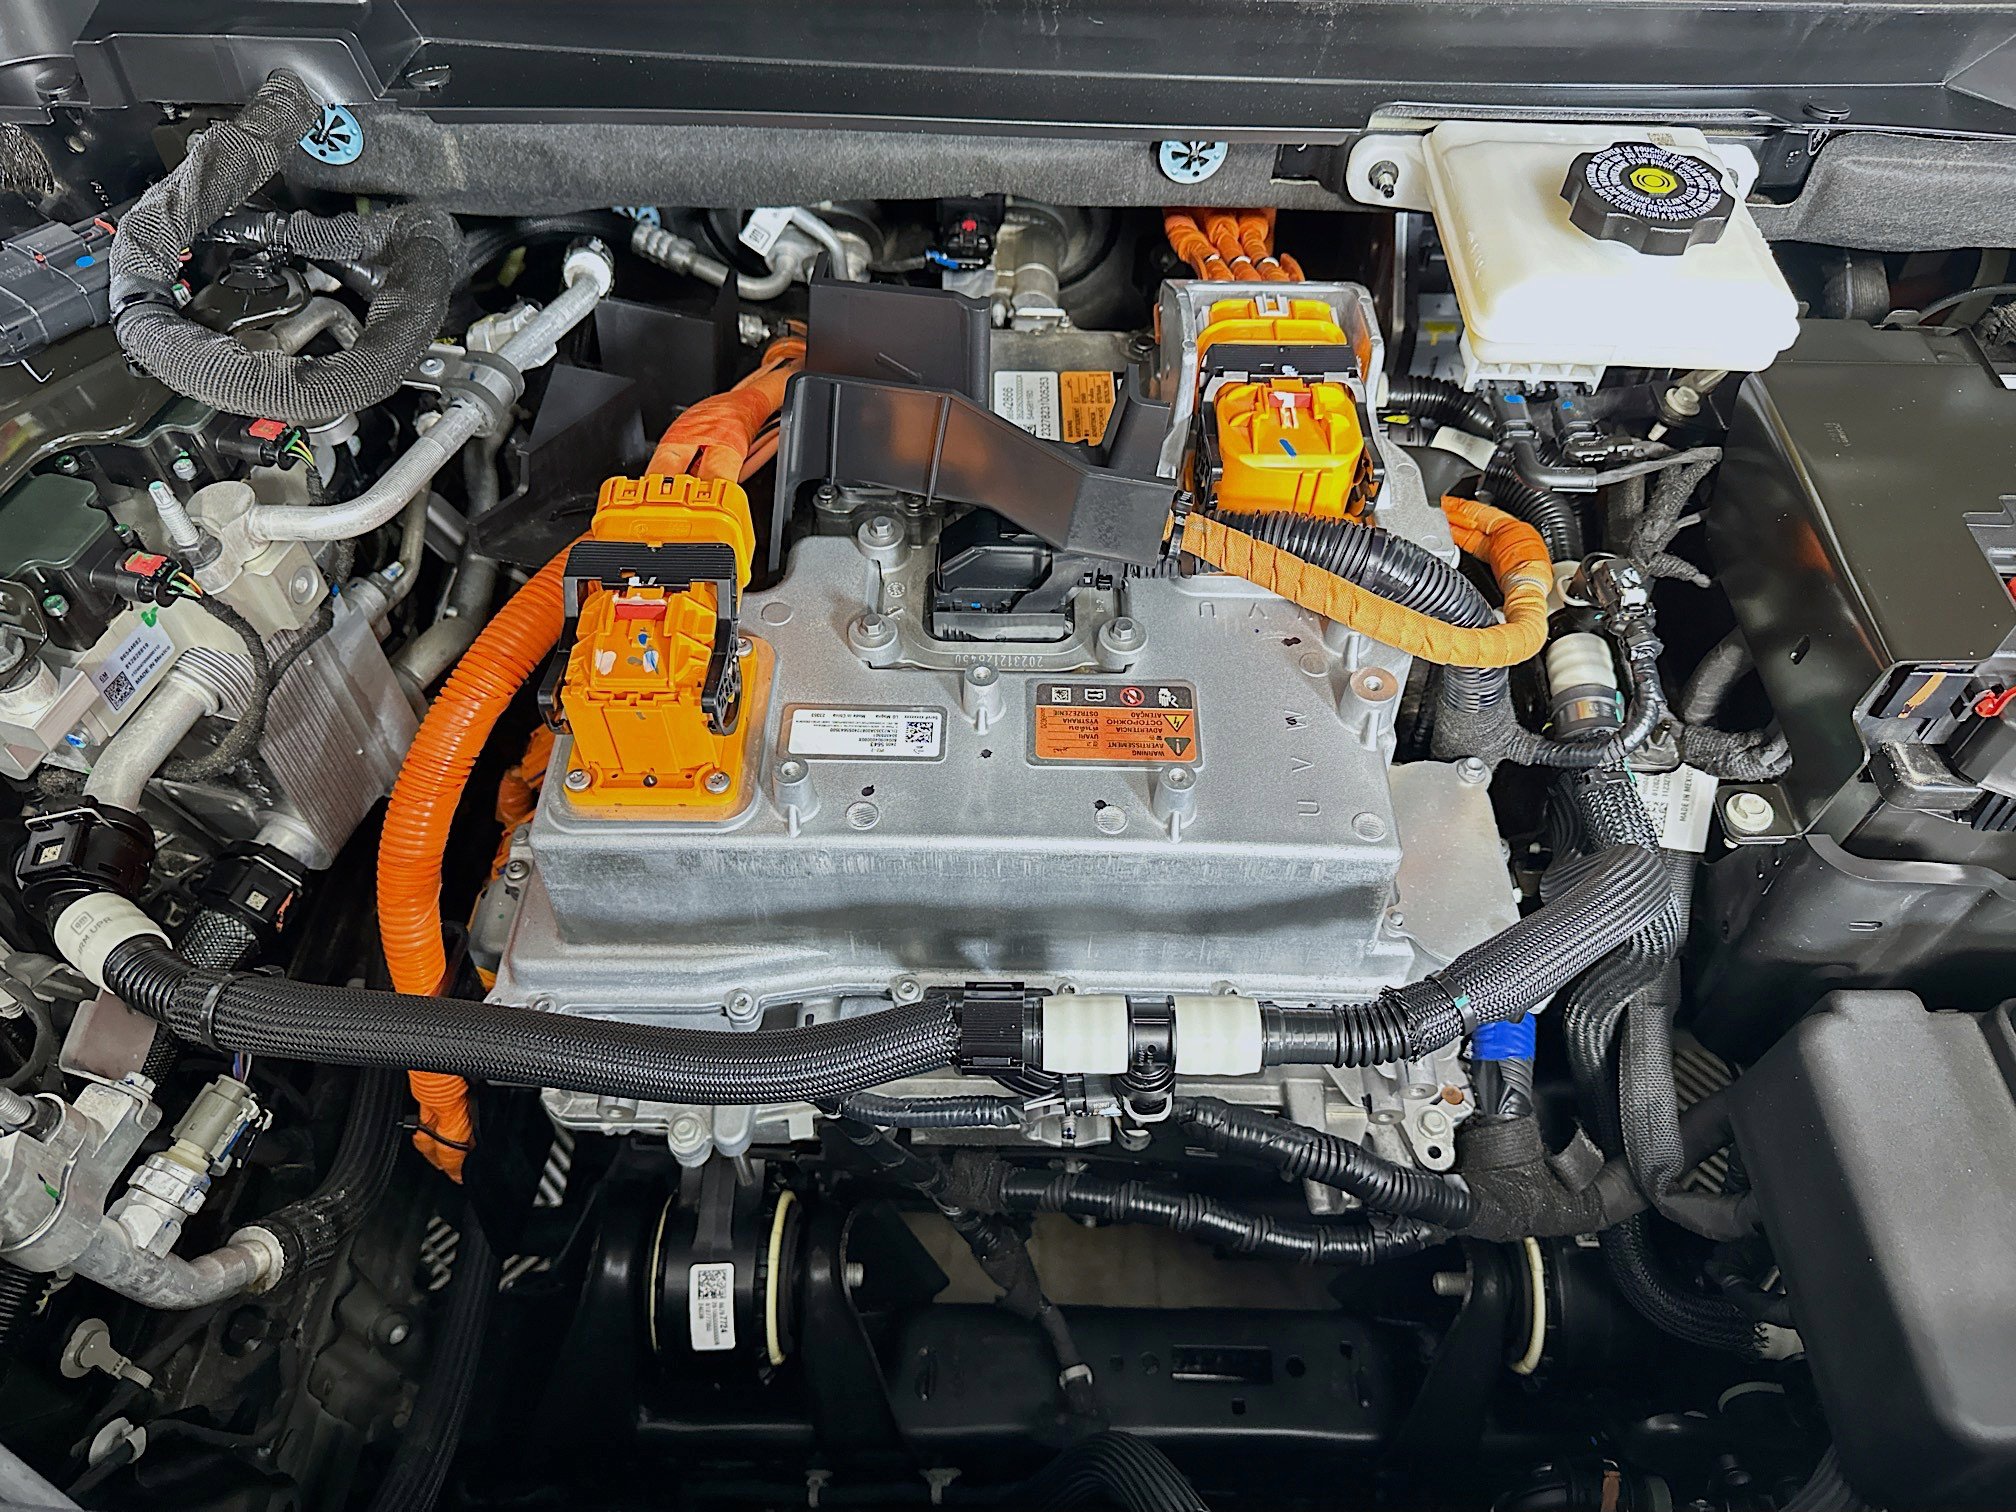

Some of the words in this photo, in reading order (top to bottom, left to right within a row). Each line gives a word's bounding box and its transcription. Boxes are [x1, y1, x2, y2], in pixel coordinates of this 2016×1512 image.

[1633, 145, 1671, 157] BOUCHON
[1637, 152, 1668, 161] LIQUIDE
[1650, 159, 1676, 171] BIDON
[1611, 199, 1635, 213] FLUID
[1635, 207, 1660, 219] FROM
[1616, 194, 1648, 209] BEFORE
[135, 668, 150, 685] MADE
[154, 645, 171, 663] Mexico
[1115, 726, 1163, 734] ADVERTENCIA
[1290, 756, 1314, 773] V
[1682, 794, 1690, 802] IN
[1297, 800, 1321, 817] U
[1679, 803, 1689, 822] MADE
[90, 916, 112, 933] UPR
